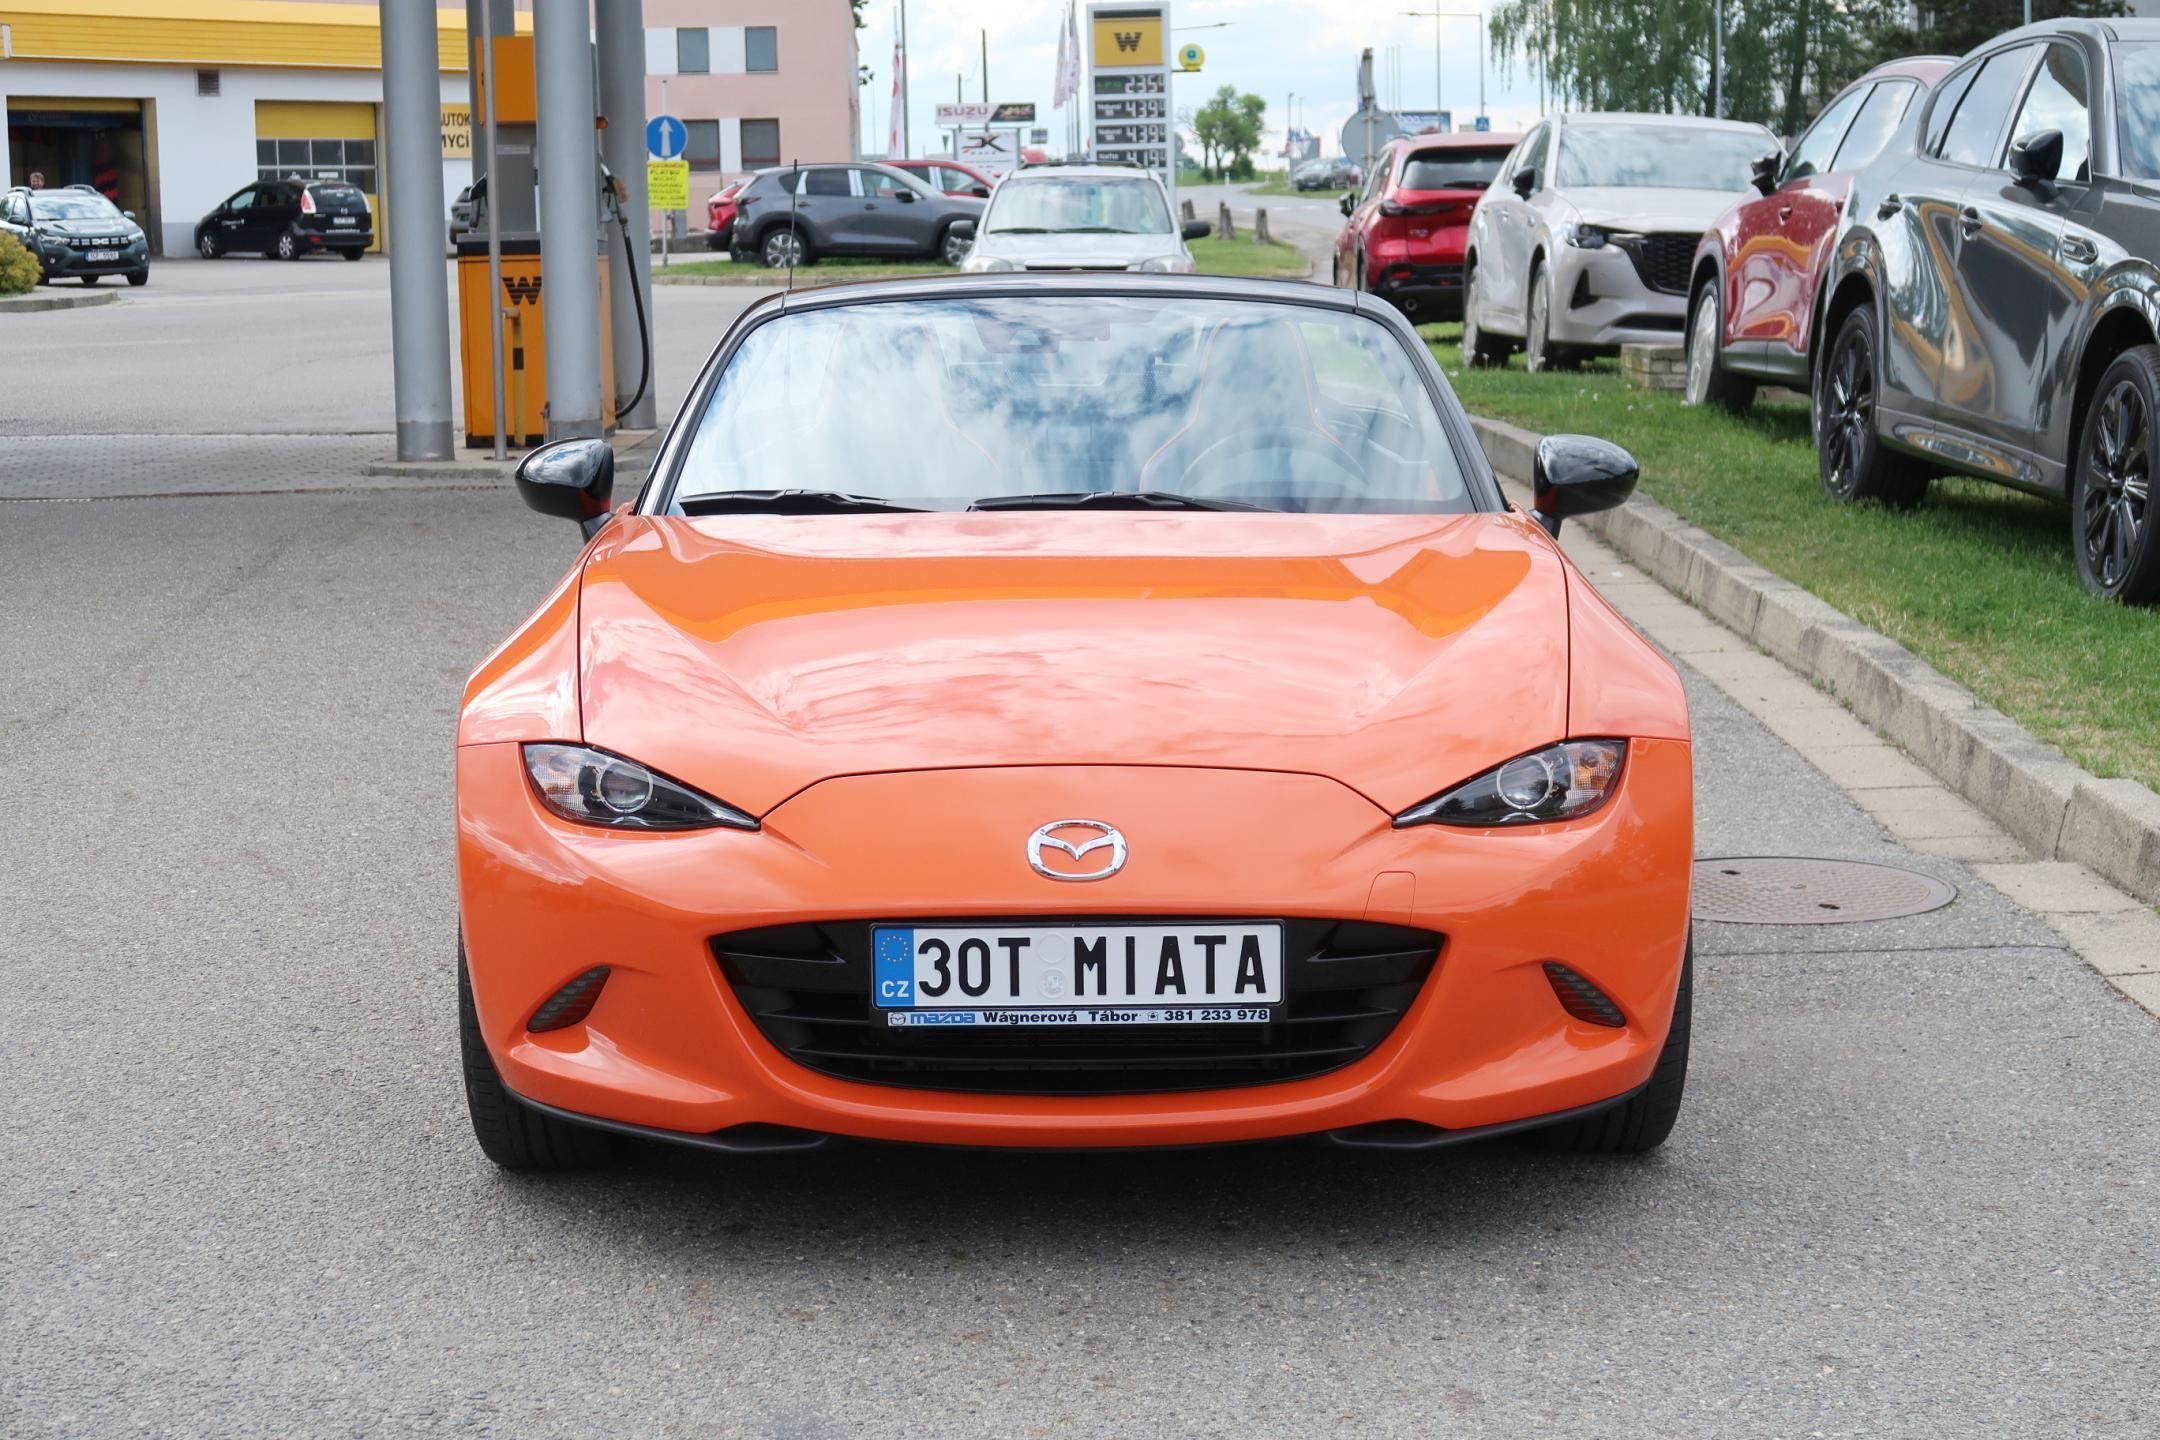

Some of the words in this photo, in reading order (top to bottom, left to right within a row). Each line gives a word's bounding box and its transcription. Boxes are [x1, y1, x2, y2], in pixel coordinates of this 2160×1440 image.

[1114, 32, 1143, 53] W
[937, 106, 988, 116] ISUZU
[881, 980, 909, 997] CZ
[1074, 935, 1267, 996] MIATA
[983, 1011, 1077, 1024] Wágnerová
[1088, 1010, 1138, 1022] Tábor
[1164, 1010, 1194, 1021] 381
[1201, 1010, 1232, 1021] 233
[1237, 1009, 1268, 1021] 978
